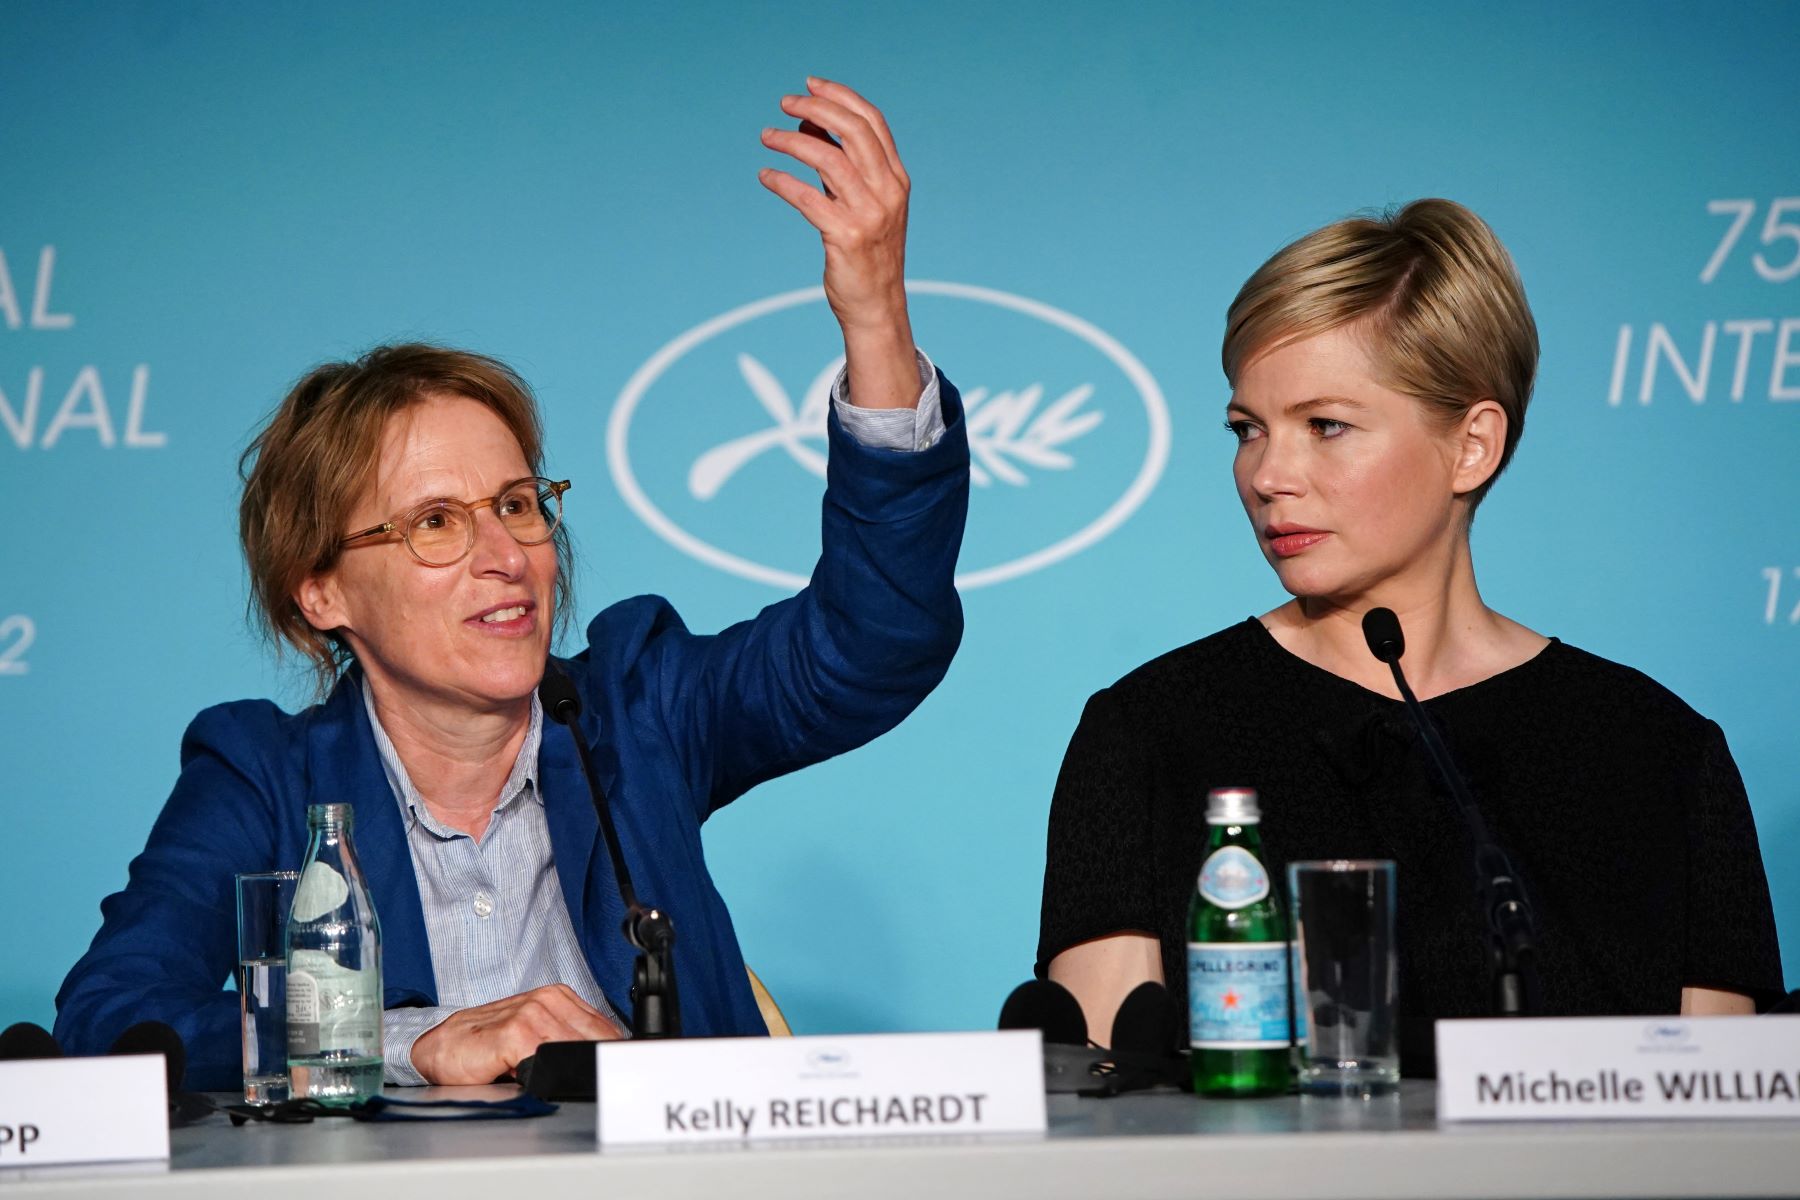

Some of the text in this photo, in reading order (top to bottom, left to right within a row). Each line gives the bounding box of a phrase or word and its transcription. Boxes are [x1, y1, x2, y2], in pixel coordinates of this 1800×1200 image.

[1608, 320, 1800, 406] INTE
[0, 364, 168, 449] NAL
[664, 1093, 987, 1136] Kelly REICHARDT
[1476, 1069, 1800, 1104] Michelle WILLIA
